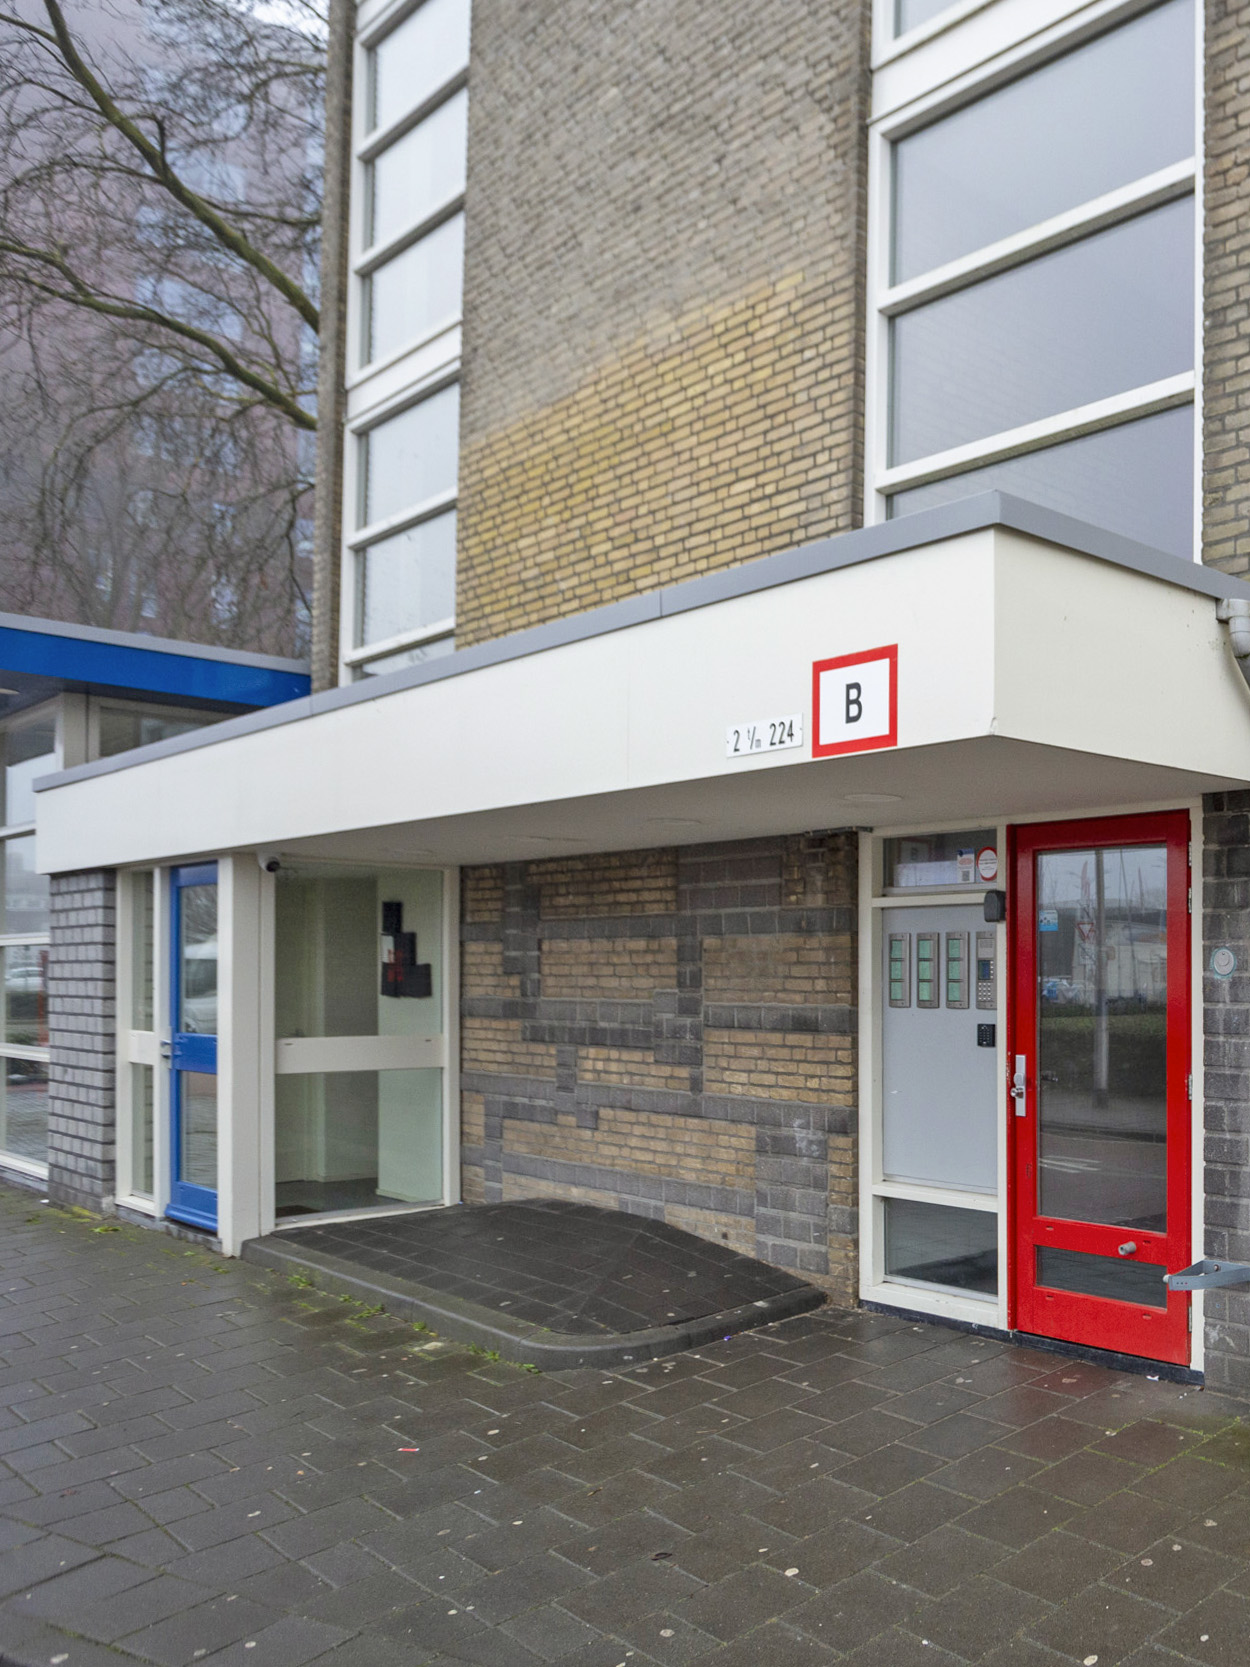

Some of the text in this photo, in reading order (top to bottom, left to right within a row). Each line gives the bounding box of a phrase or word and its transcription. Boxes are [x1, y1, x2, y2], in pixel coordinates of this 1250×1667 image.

[845, 682, 863, 724] B
[733, 729, 741, 753] 2
[769, 719, 795, 746] 224
